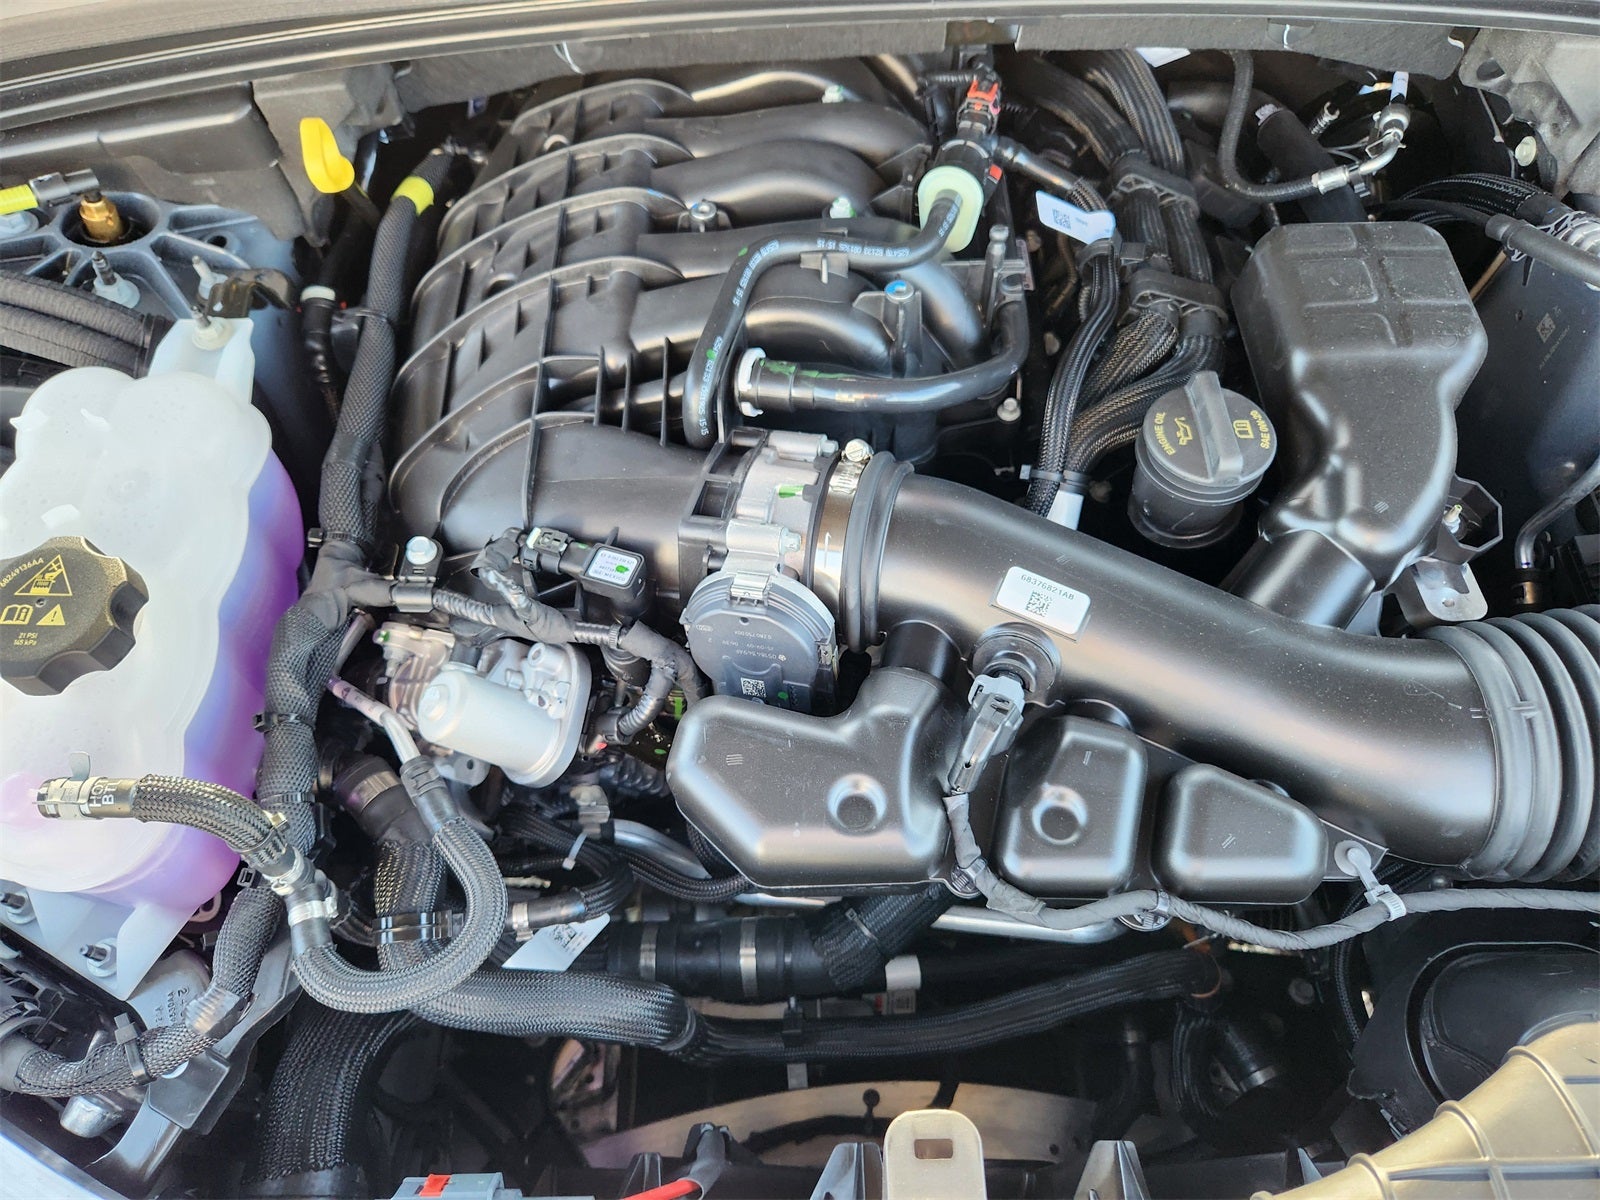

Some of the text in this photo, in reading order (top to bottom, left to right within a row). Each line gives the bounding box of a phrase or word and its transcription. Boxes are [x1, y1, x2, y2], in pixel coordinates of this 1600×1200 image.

[1154, 411, 1176, 456] ENGINE OIL
[1250, 410, 1271, 449] SAE 0W-20
[0, 557, 45, 588] 68249136AA
[1020, 574, 1075, 601] 68376821AB
[88, 779, 109, 808] HOT
